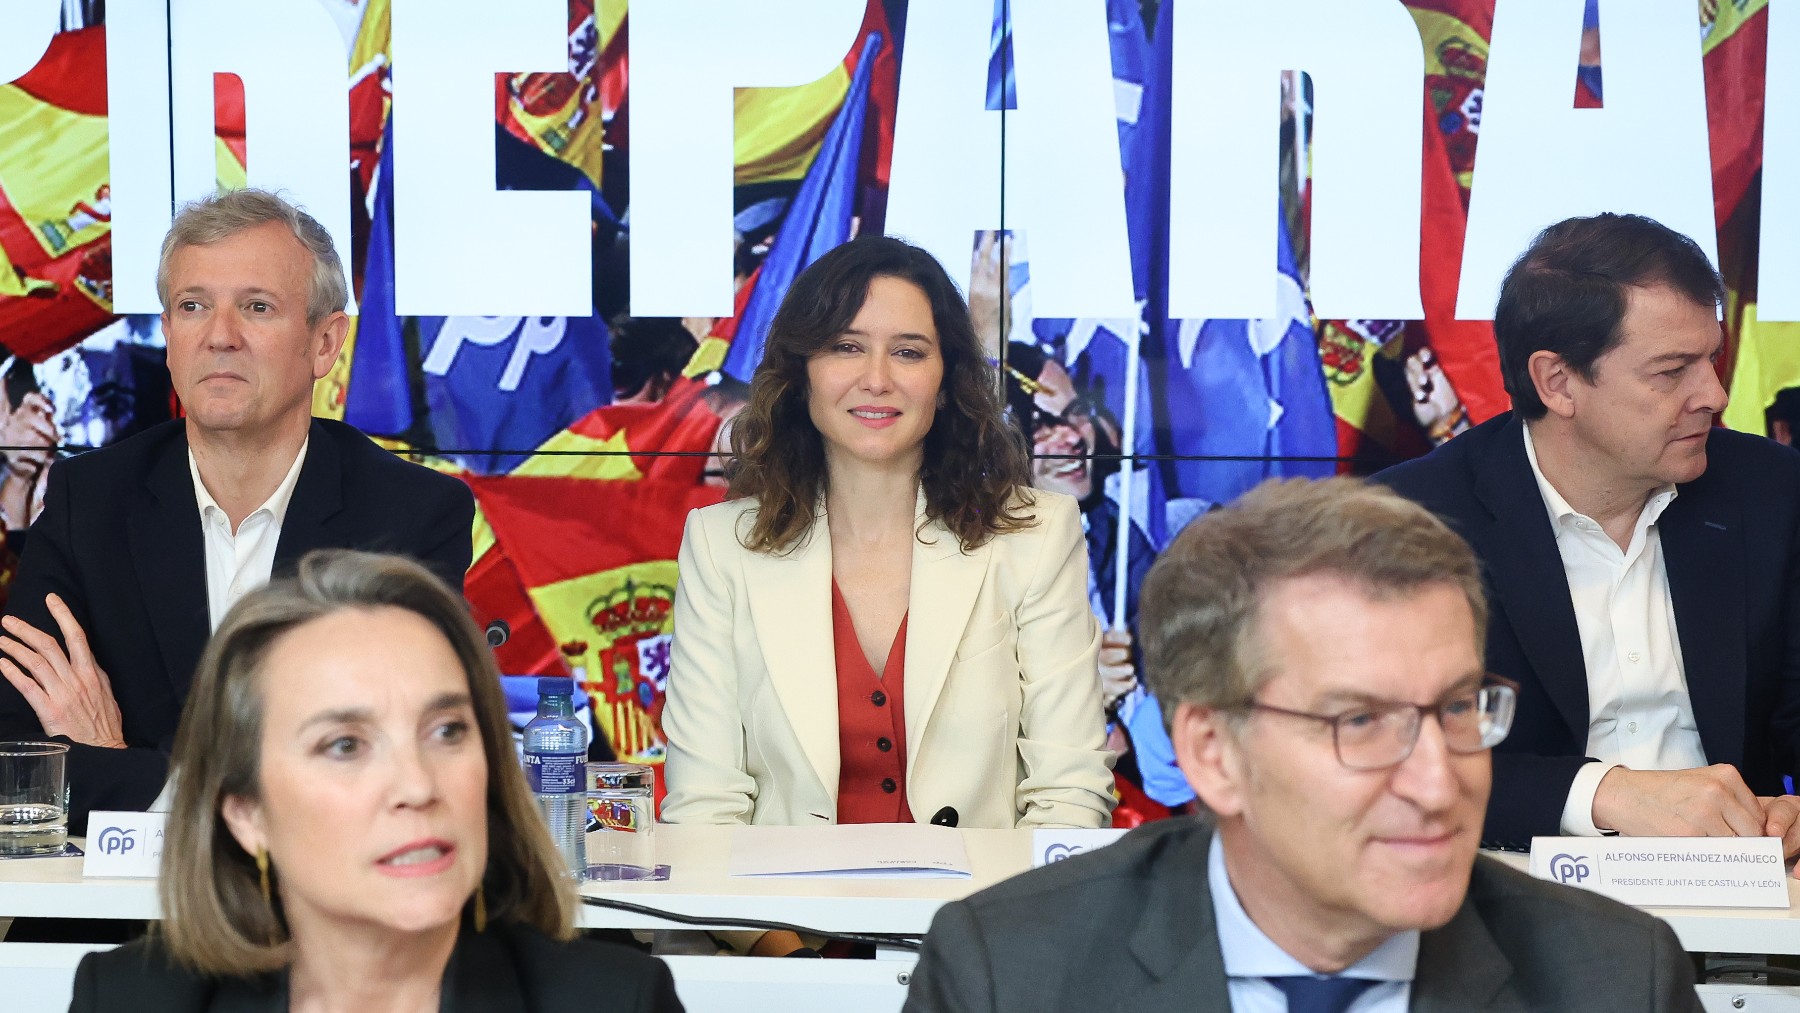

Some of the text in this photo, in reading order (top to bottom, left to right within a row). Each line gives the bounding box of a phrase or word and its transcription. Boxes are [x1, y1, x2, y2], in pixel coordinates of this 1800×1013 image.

[1605, 852, 1778, 864] ALFONSO FERNÁNDEZ MAÑUECO
[1611, 878, 1781, 888] PRESIDENTE JUNTA DE CASTILLA Y LEÓN
